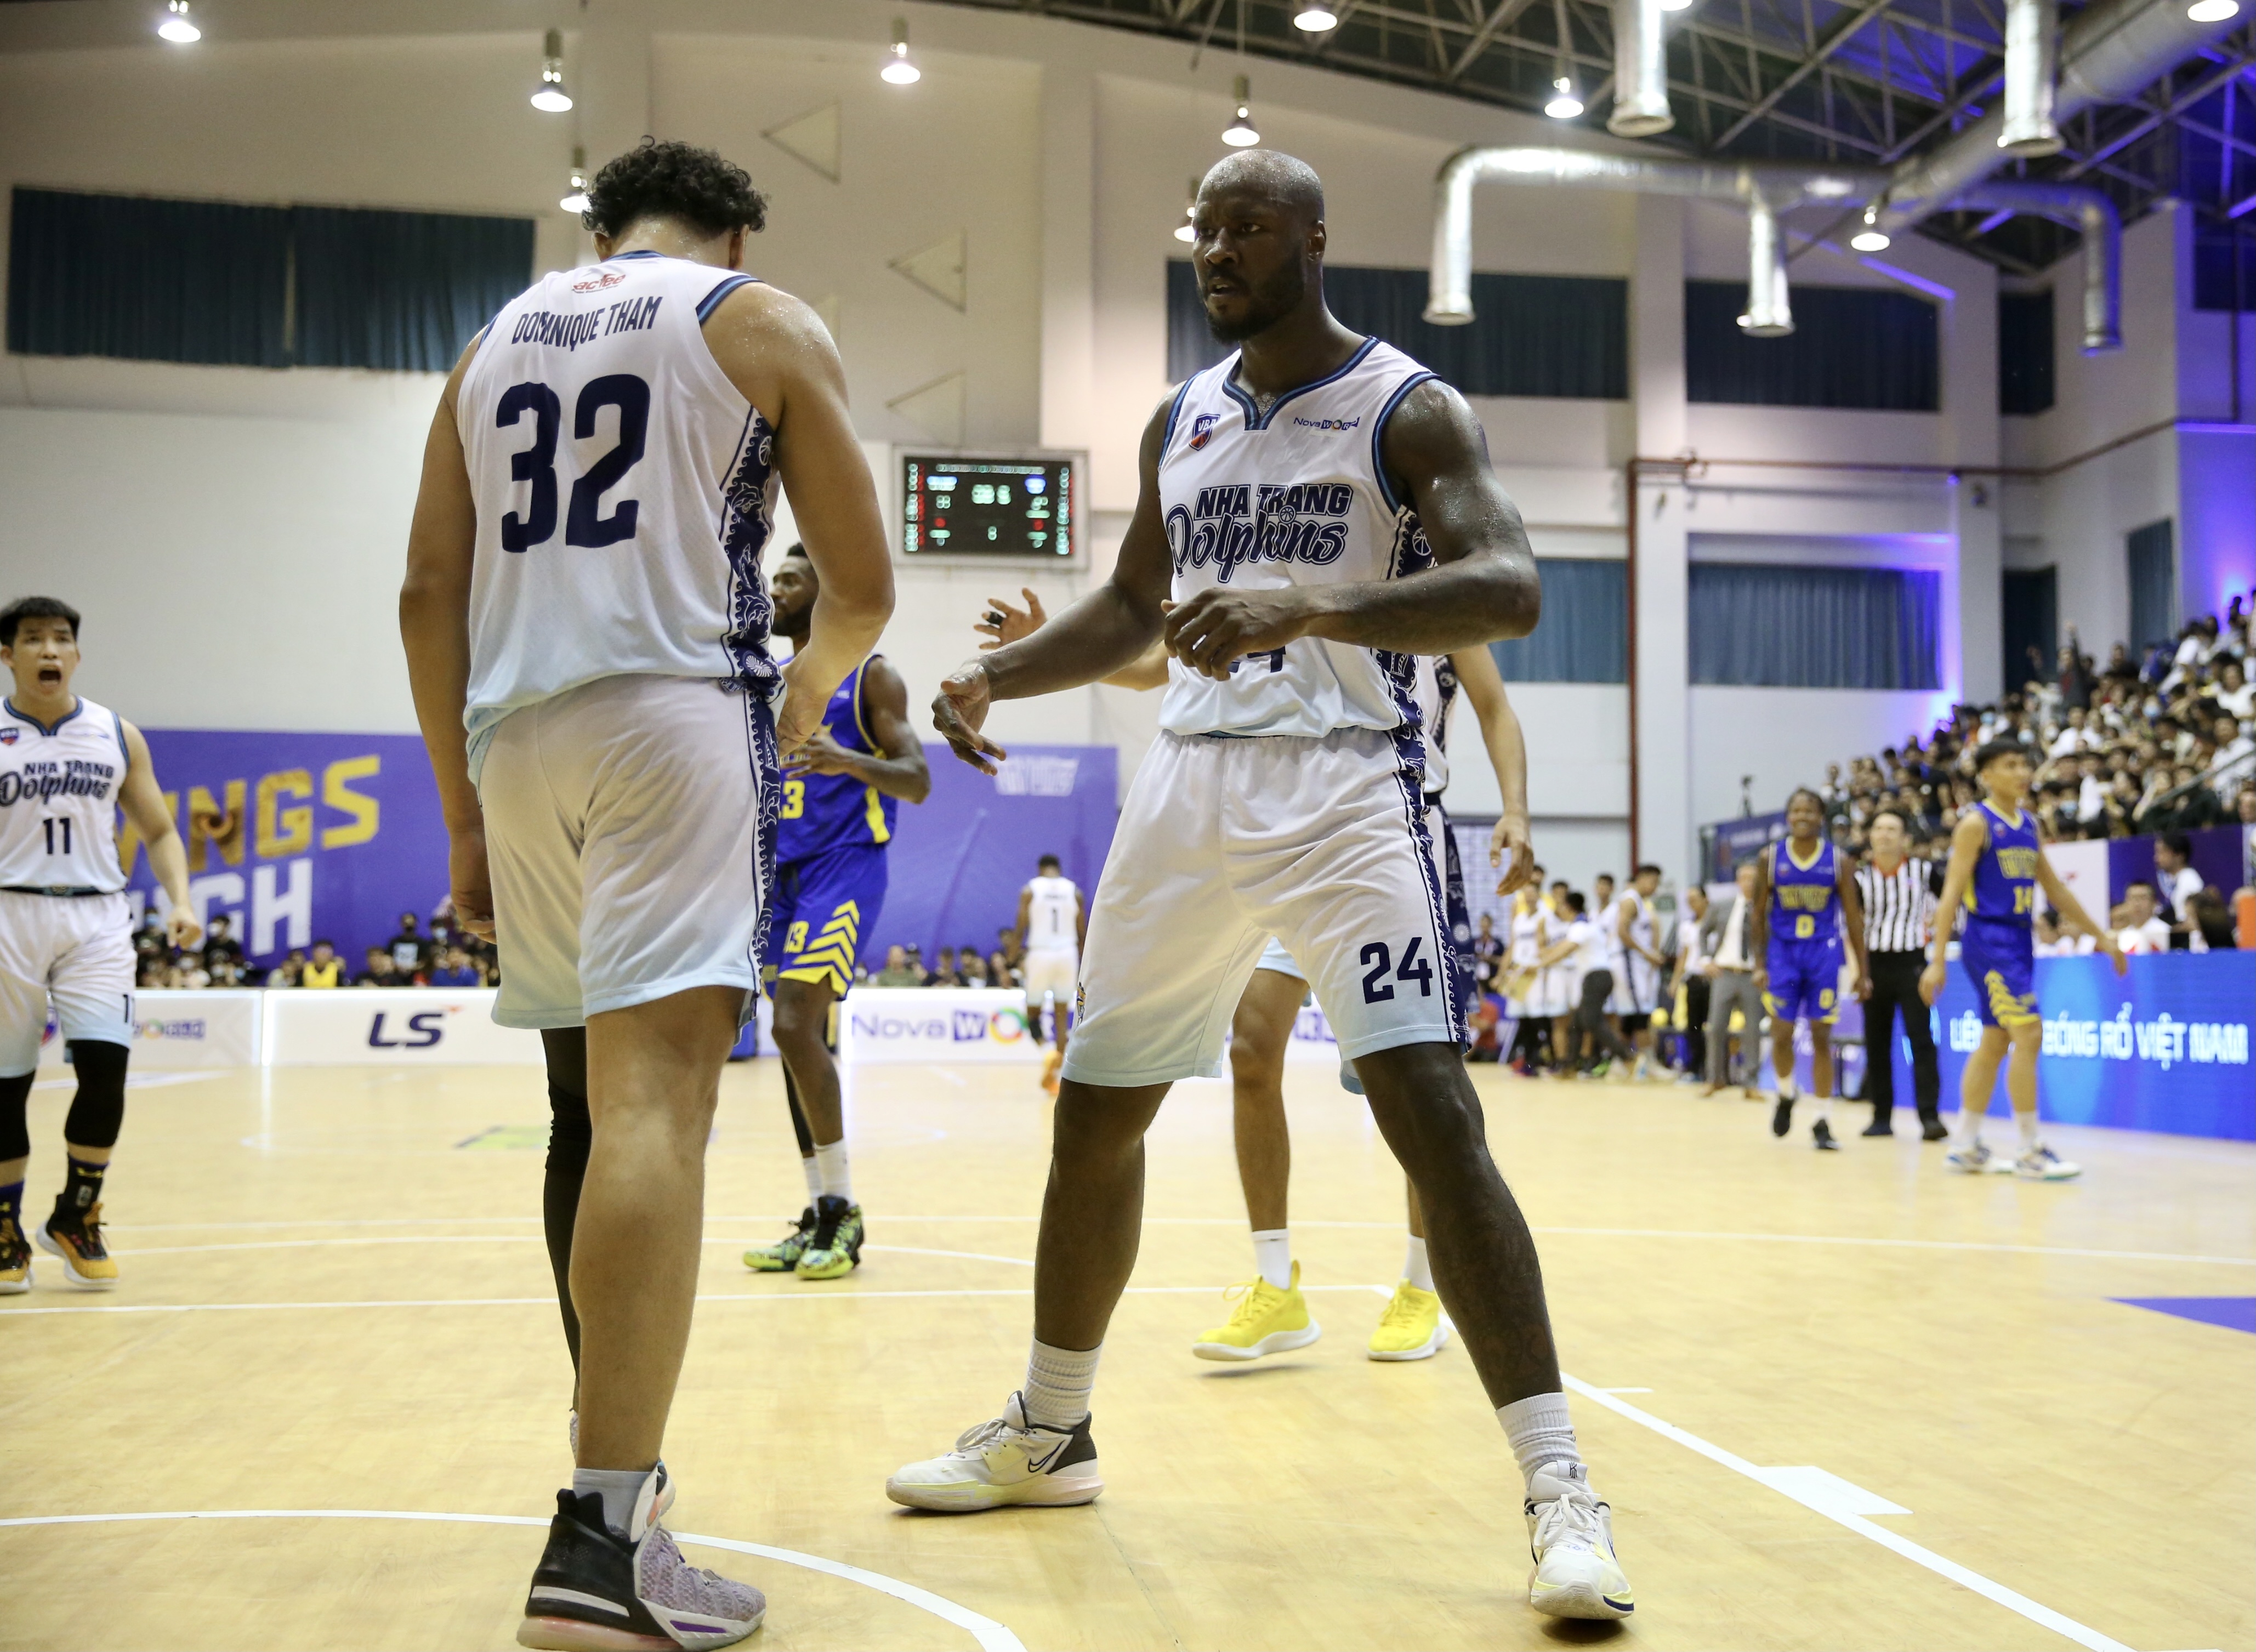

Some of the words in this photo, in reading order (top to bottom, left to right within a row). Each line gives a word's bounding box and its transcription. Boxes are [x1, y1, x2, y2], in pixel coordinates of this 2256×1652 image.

[511, 308, 605, 352] DOMINIQUE
[604, 296, 663, 337] THAM
[1293, 416, 1360, 430] NovaWOR
[496, 374, 651, 553] 32
[1194, 484, 1251, 520] NHA
[1256, 482, 1354, 517] TRANG
[1165, 503, 1348, 583] Dolphins
[24, 762, 58, 776] NHA
[64, 760, 114, 779] TRANG
[0, 771, 110, 807] Dolphins
[778, 780, 805, 819] 3
[43, 817, 71, 854] 11
[1360, 936, 1433, 1004] 24
[369, 1013, 442, 1047] LS
[851, 1007, 1075, 1044] NovaWO
[1950, 1009, 1984, 1052] LIÊ
